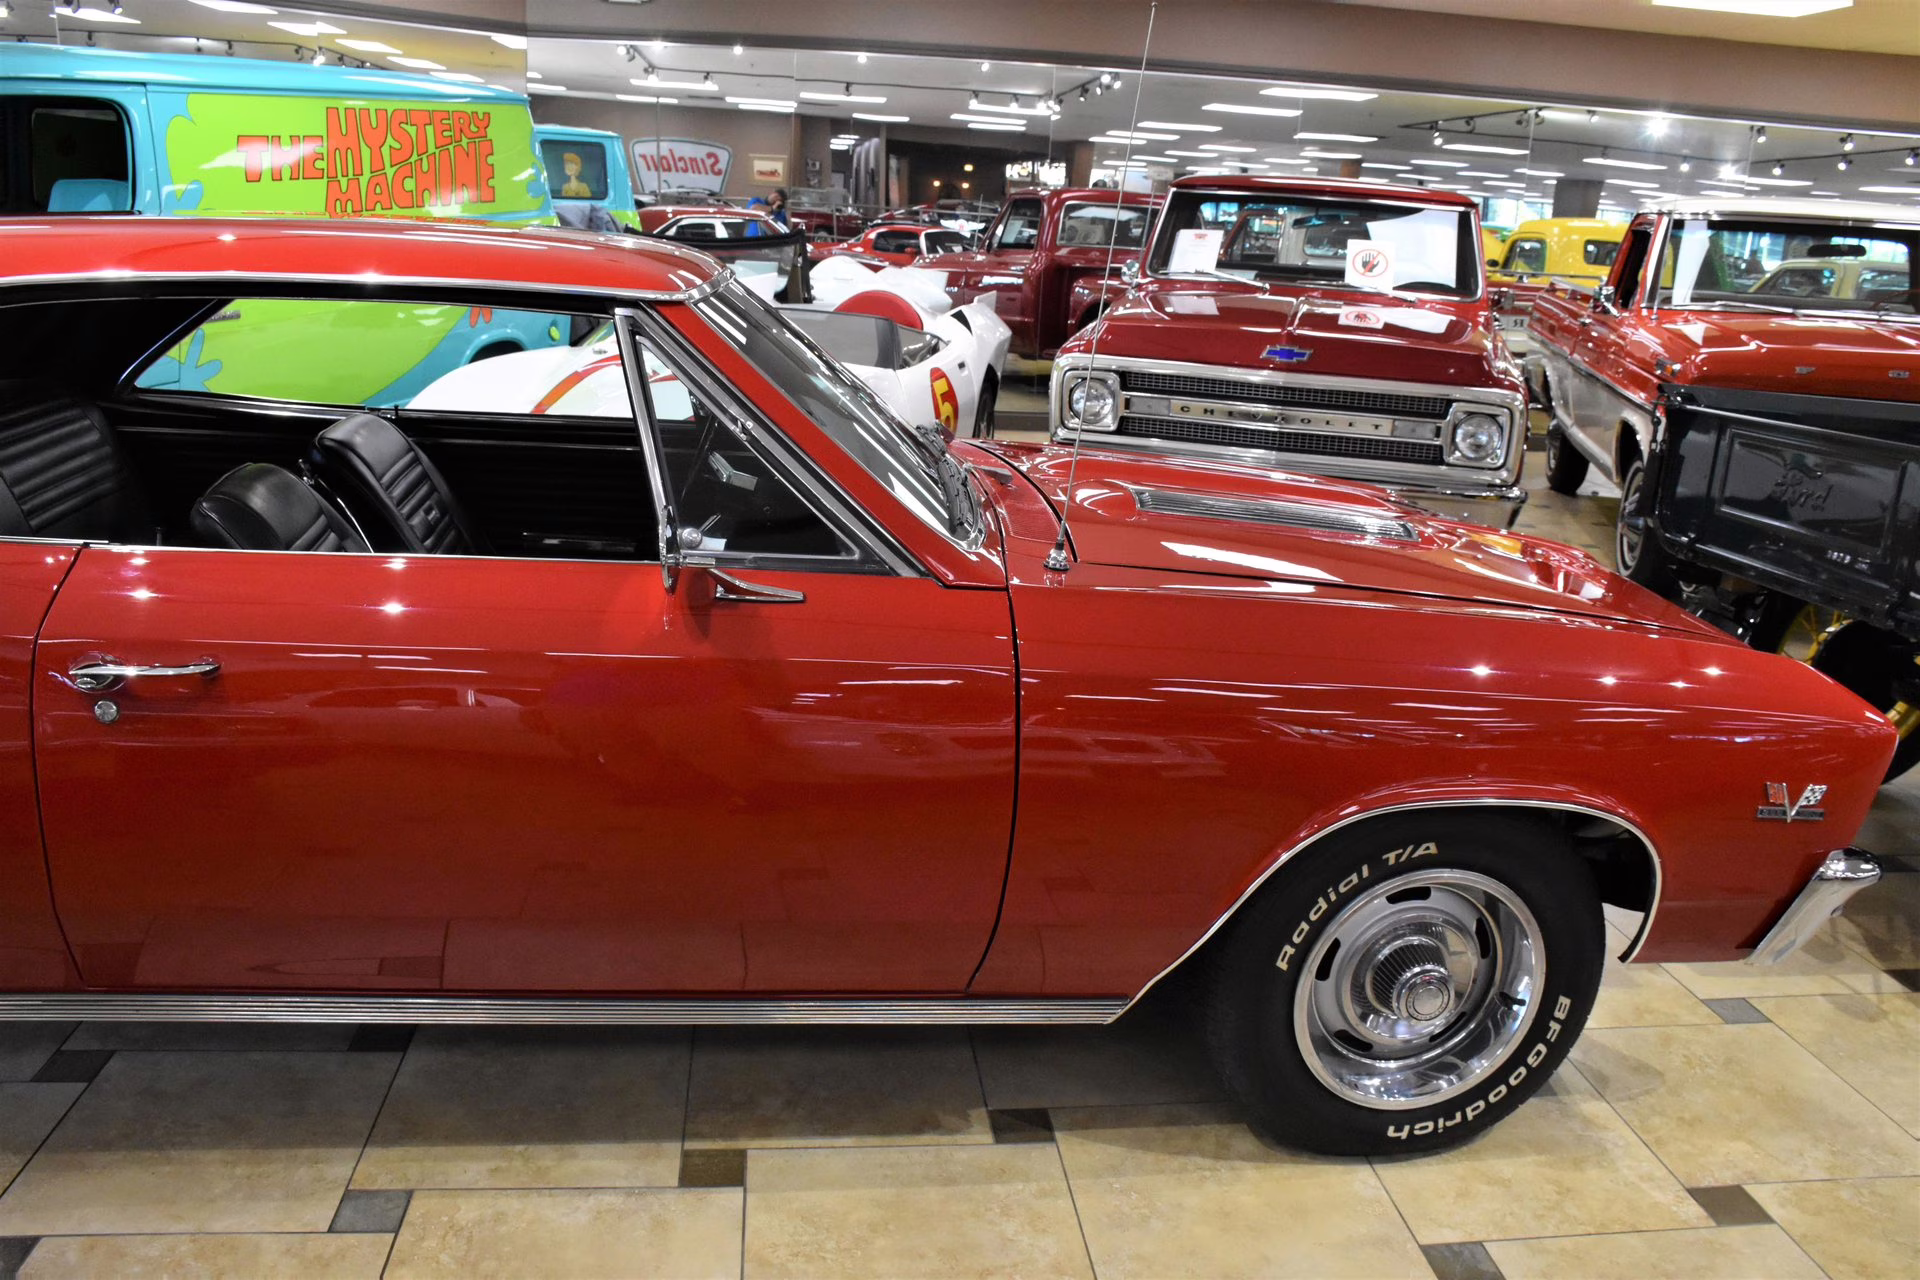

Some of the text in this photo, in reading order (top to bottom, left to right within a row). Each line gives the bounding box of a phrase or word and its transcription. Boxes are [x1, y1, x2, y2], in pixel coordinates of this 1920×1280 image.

[237, 107, 491, 182] THE MYSTERY
[325, 139, 496, 215] MACHINE
[932, 377, 954, 433] 5
[1180, 404, 1383, 431] CHEVROLET
[1275, 842, 1439, 973] Radial T/A
